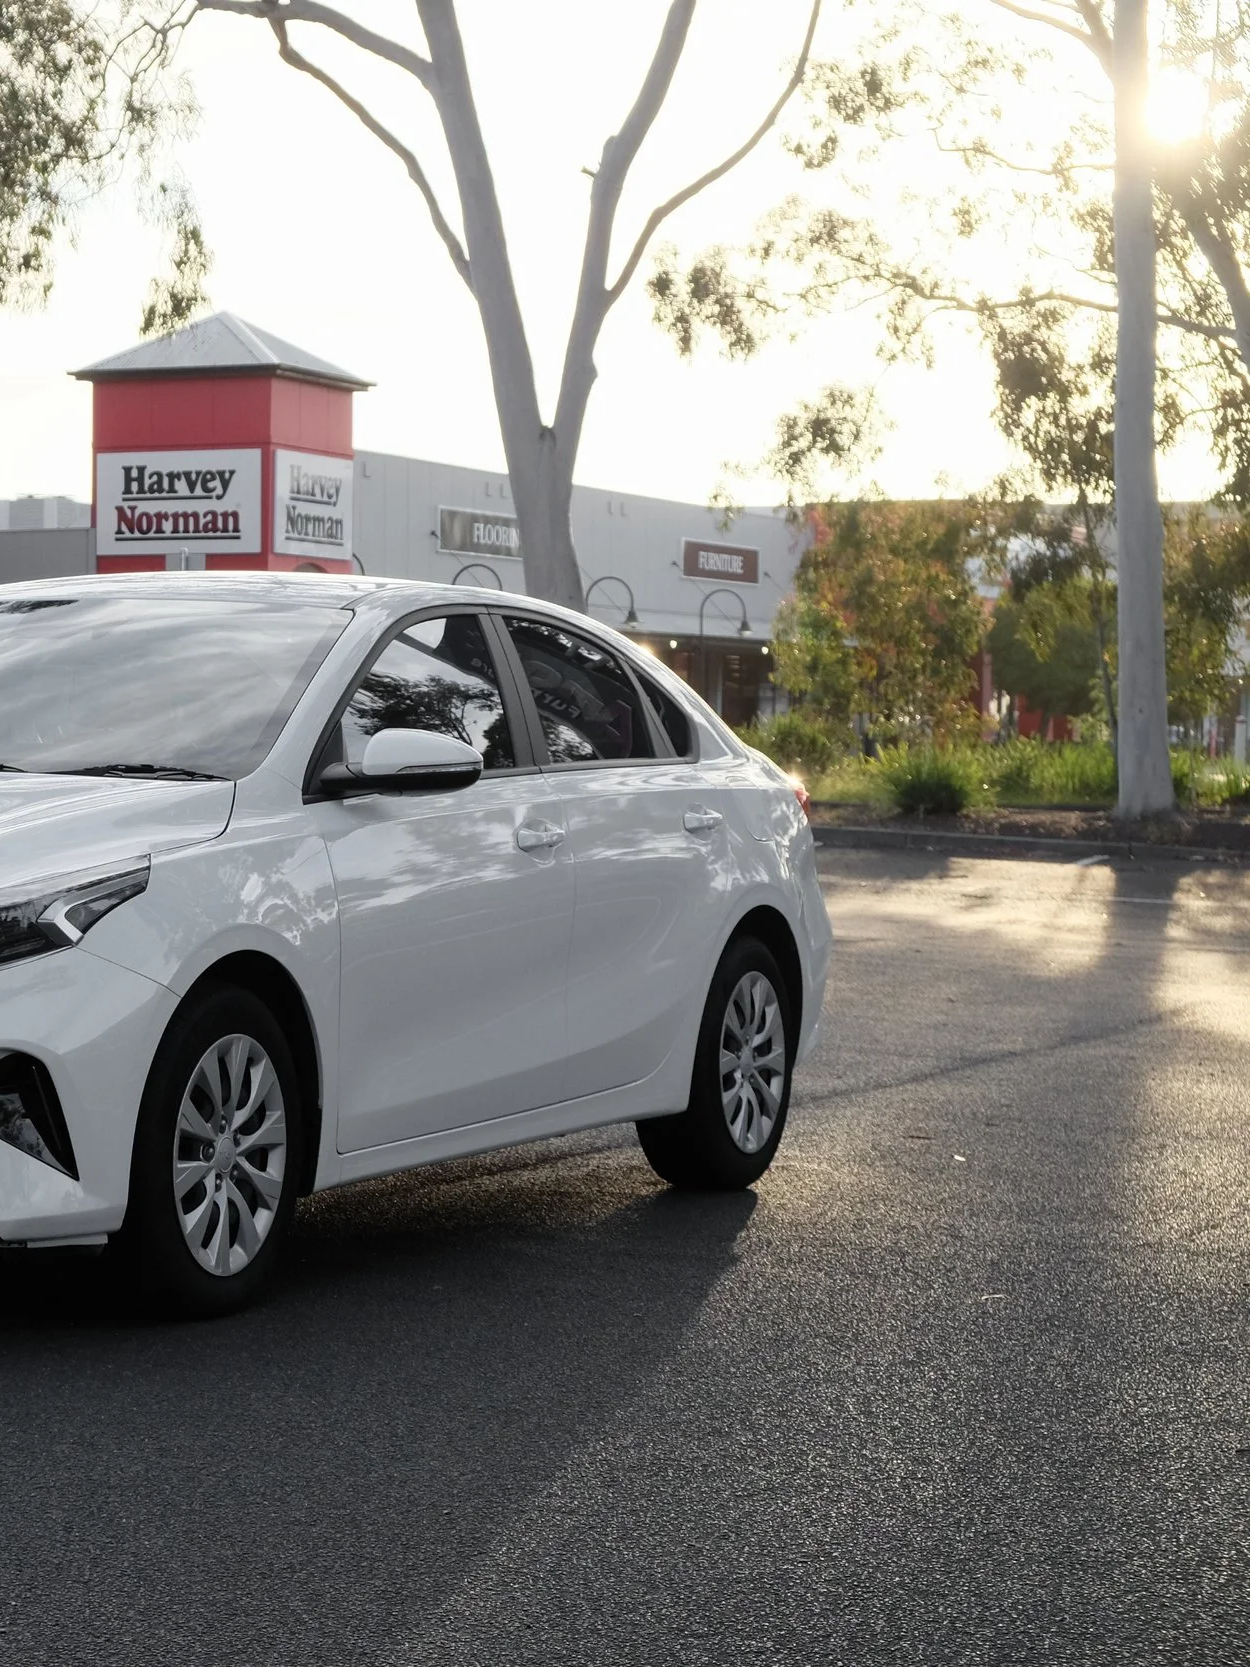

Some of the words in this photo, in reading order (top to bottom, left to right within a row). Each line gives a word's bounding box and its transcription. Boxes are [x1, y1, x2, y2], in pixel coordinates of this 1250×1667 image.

[121, 464, 236, 500] Harvey
[289, 463, 343, 507] Harvey
[114, 505, 241, 535] Norman
[285, 503, 344, 541] Norman
[473, 522, 520, 548] FLOORIN
[697, 550, 745, 574] FURNITURE
